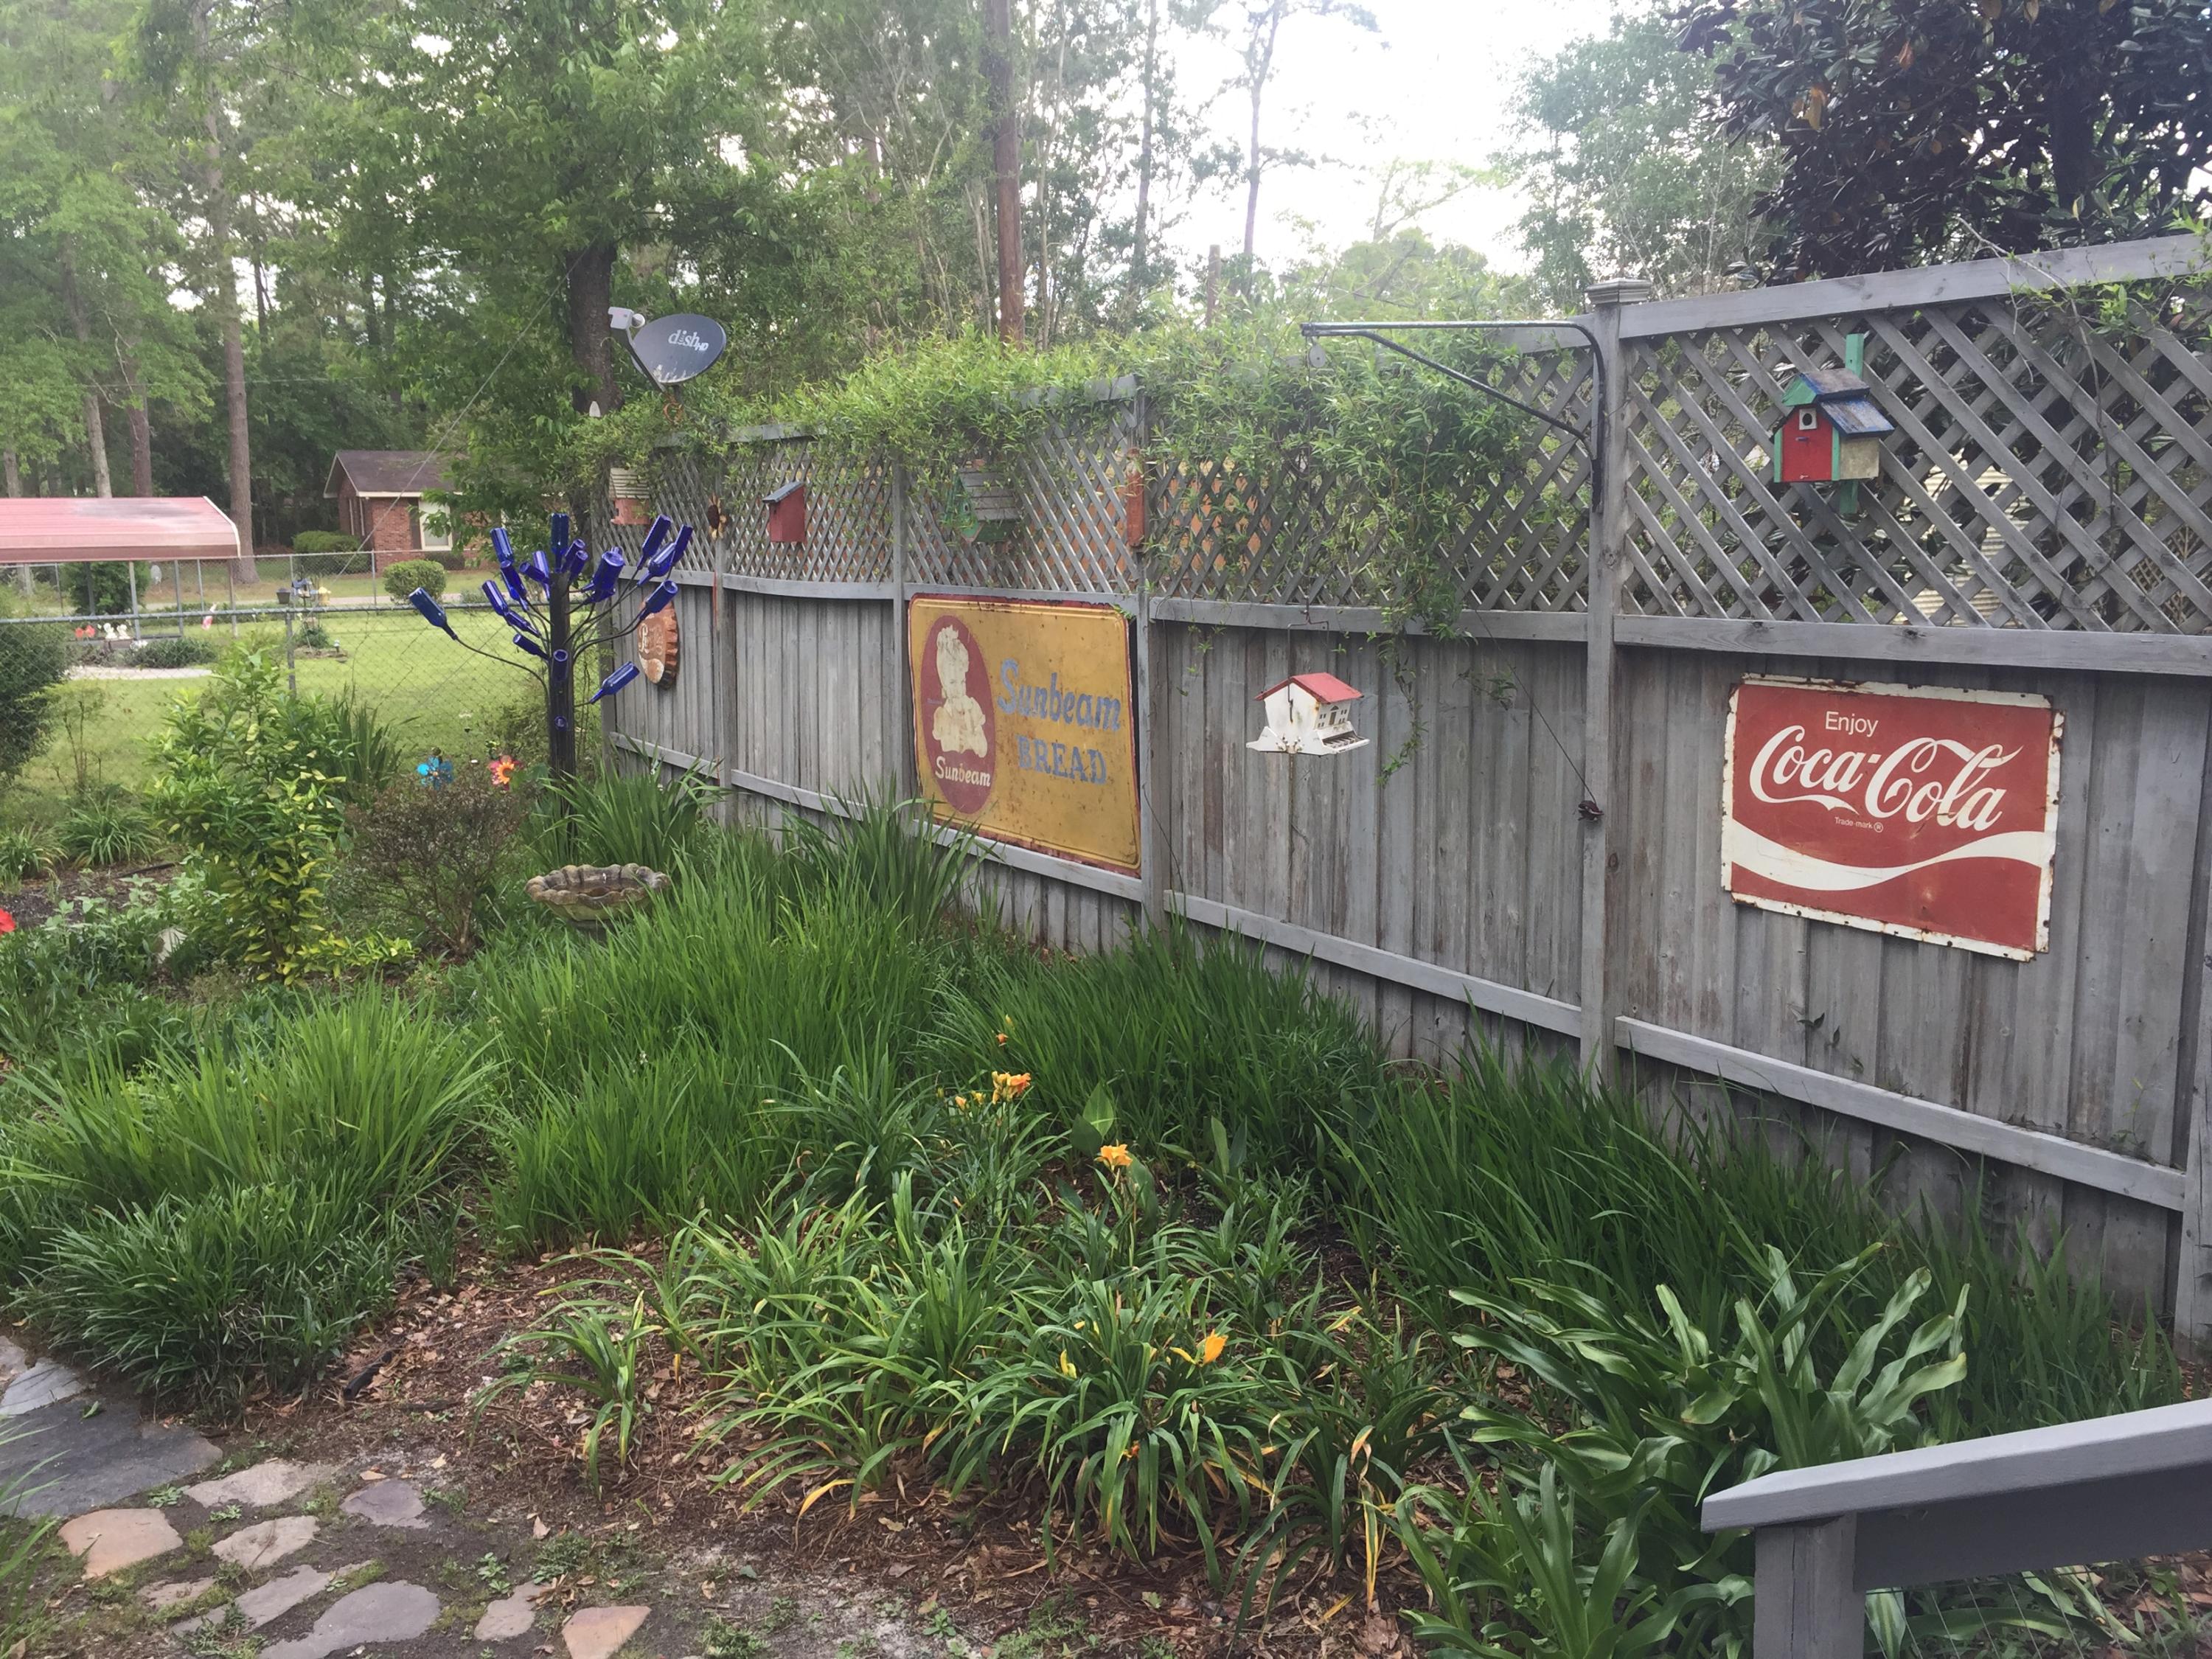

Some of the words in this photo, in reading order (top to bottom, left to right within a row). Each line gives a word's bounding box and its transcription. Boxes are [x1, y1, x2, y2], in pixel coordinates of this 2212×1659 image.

[998, 658, 1121, 731] Sunbeam
[1826, 711, 1879, 737] Enjoy
[935, 756, 991, 787] Sunbeam
[1015, 734, 1106, 784] BREAD
